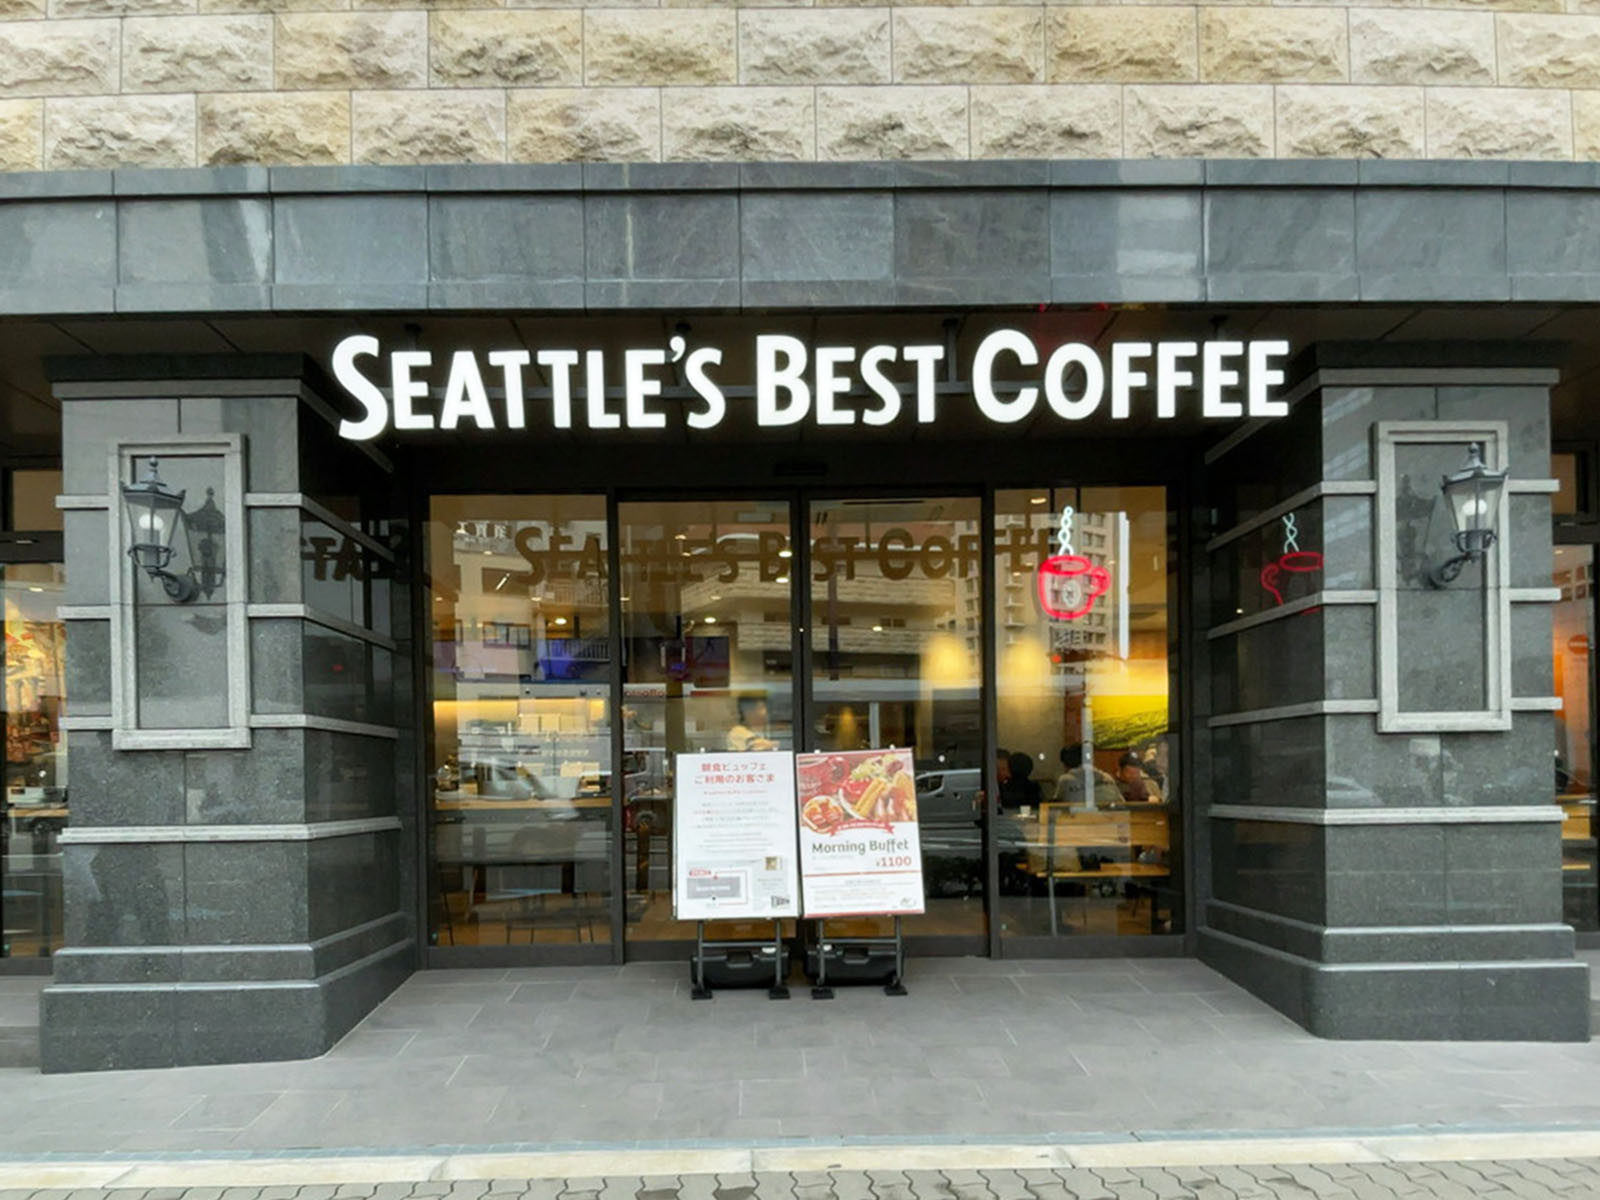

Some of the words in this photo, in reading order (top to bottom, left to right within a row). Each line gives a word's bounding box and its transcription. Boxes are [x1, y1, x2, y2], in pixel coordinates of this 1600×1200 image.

[332, 334, 728, 441] SEATTLE'S
[755, 334, 945, 426] BEST
[972, 329, 1290, 423] COFFEE
[759, 530, 860, 582] BST
[811, 841, 866, 856] Morning
[869, 839, 909, 853] Buffet
